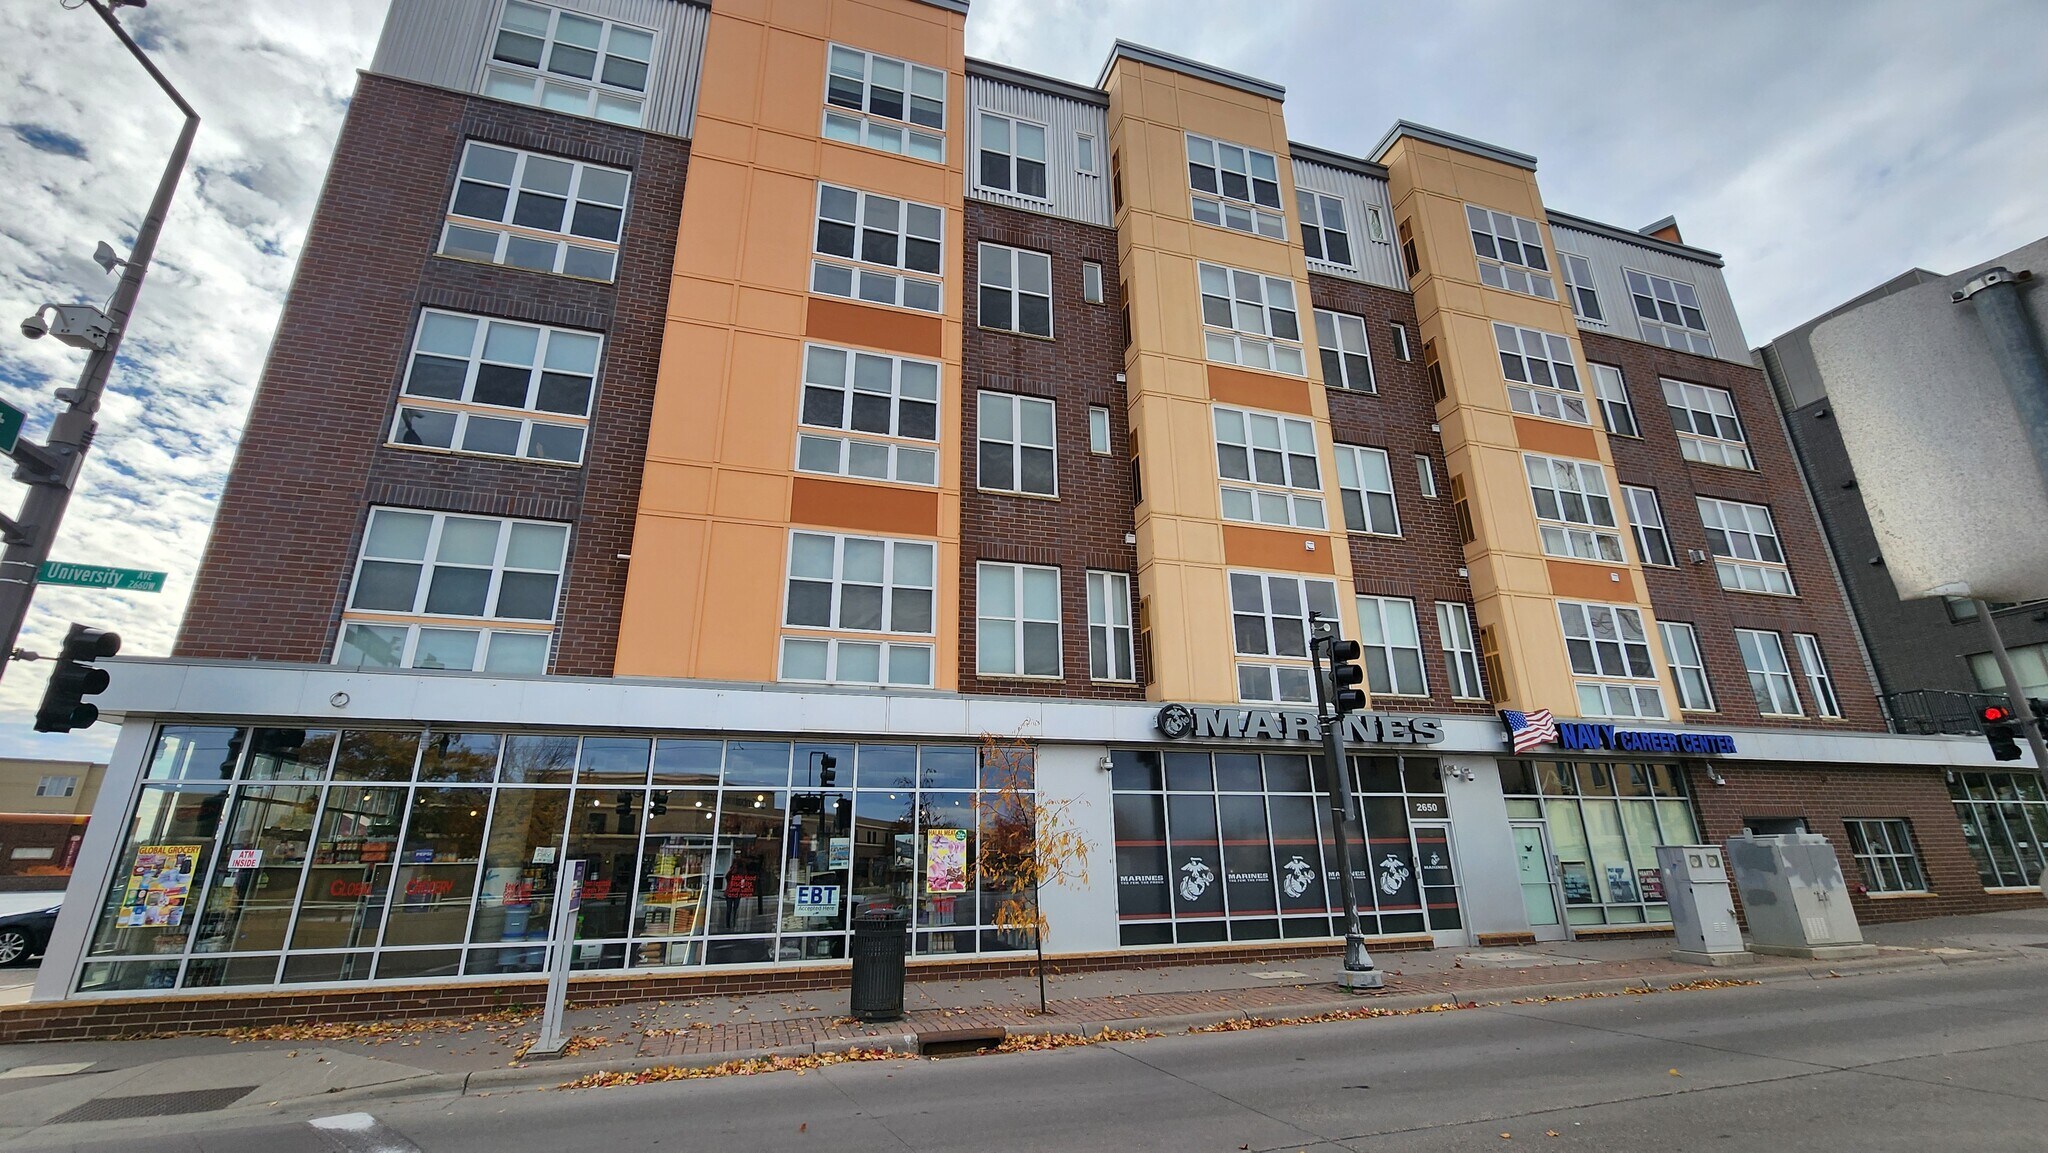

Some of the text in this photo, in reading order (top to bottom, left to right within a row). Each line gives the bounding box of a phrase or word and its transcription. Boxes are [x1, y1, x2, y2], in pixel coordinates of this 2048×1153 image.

[47, 562, 123, 588] University
[136, 567, 154, 580] AVE
[1193, 707, 1445, 744] MARNES
[1559, 723, 1738, 753] NAVY CAREER CENTER
[1416, 803, 1438, 812] 2650
[139, 846, 200, 855] GLOBAL GROCERY
[238, 850, 254, 859] ATM
[231, 859, 257, 867] INSIDE
[797, 886, 838, 904] EBT
